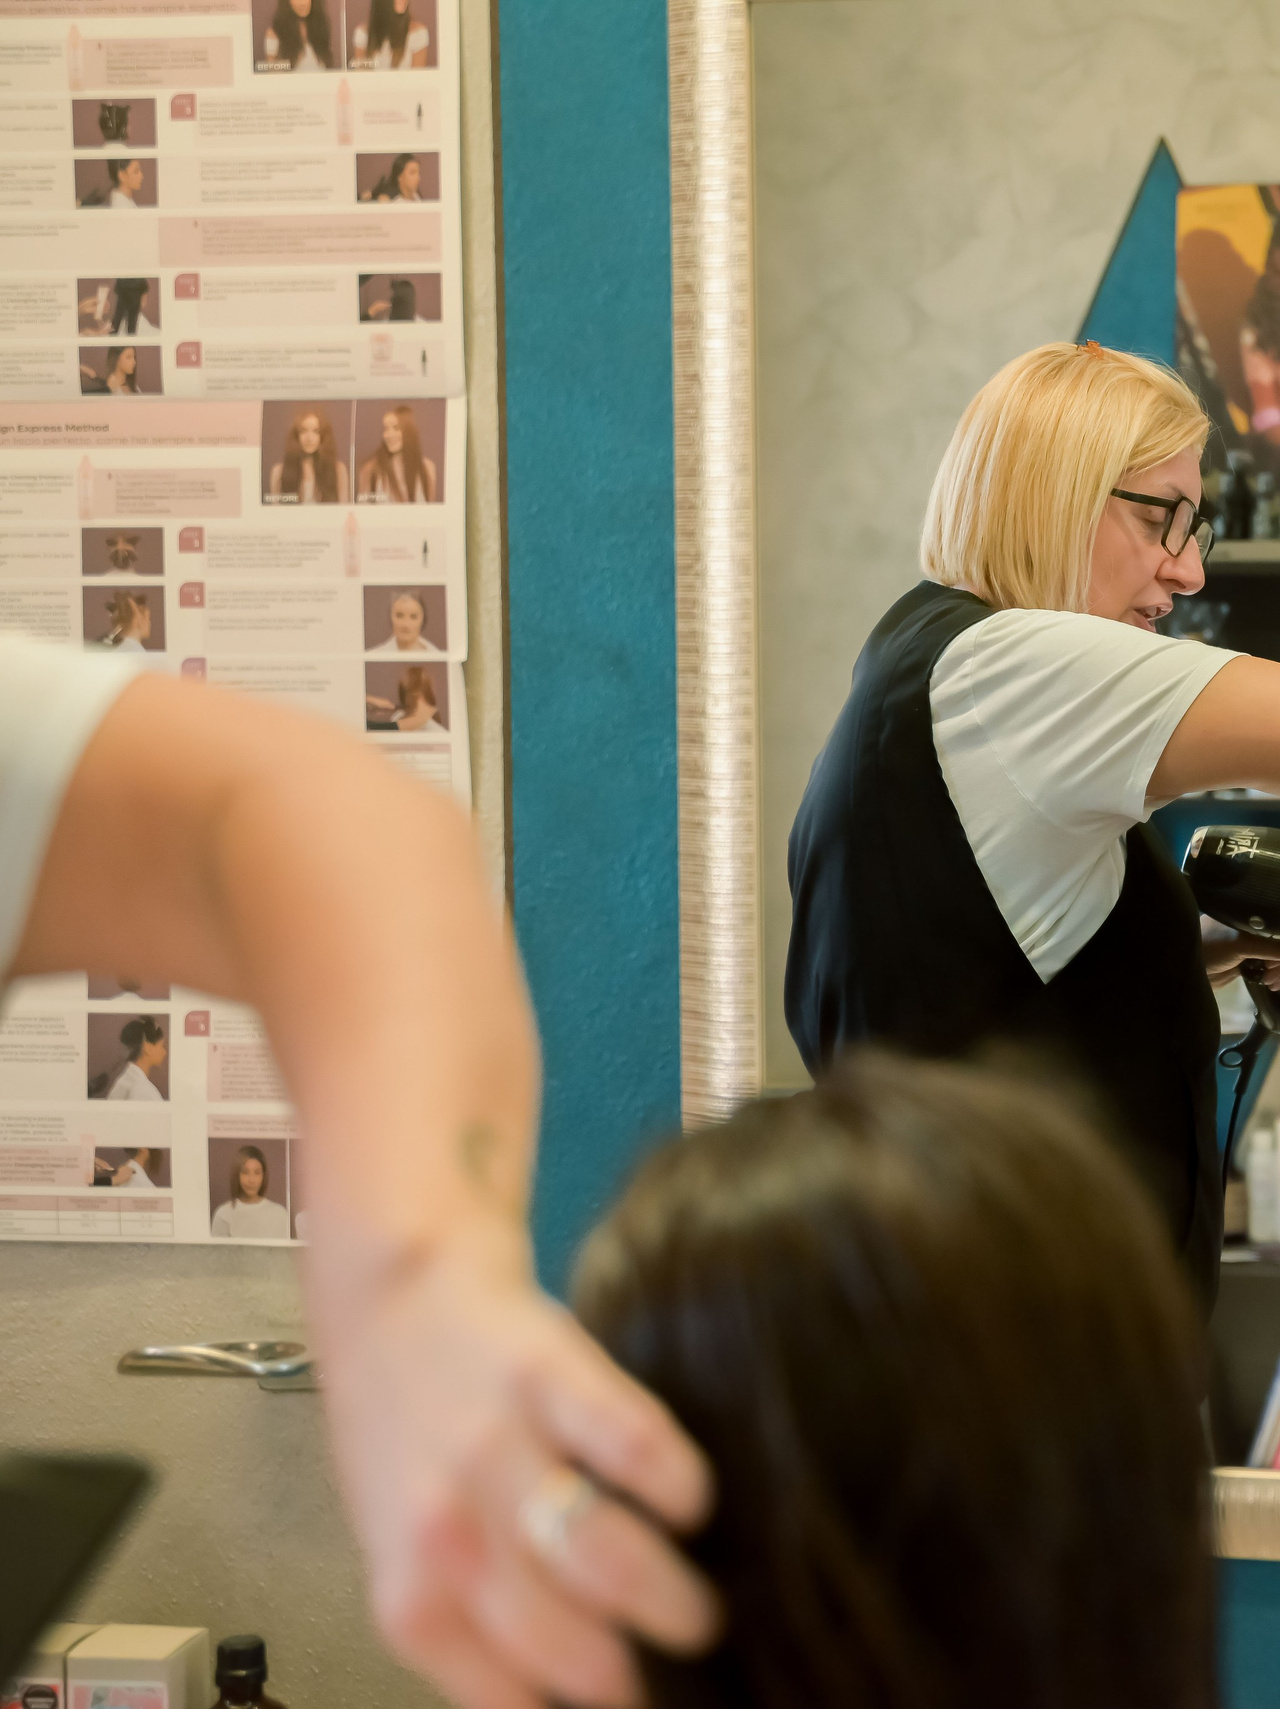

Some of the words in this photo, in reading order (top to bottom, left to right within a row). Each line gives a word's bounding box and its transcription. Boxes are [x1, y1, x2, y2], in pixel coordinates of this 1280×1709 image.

[141, 4, 185, 14] sempre
[257, 62, 292, 71] BEFORE
[17, 423, 63, 434] Express
[65, 422, 110, 433] Method
[13, 437, 42, 446] liscio
[96, 437, 129, 446] come
[152, 436, 195, 446] sempre
[198, 435, 247, 445] sognato
[265, 494, 298, 503] BEFORE
